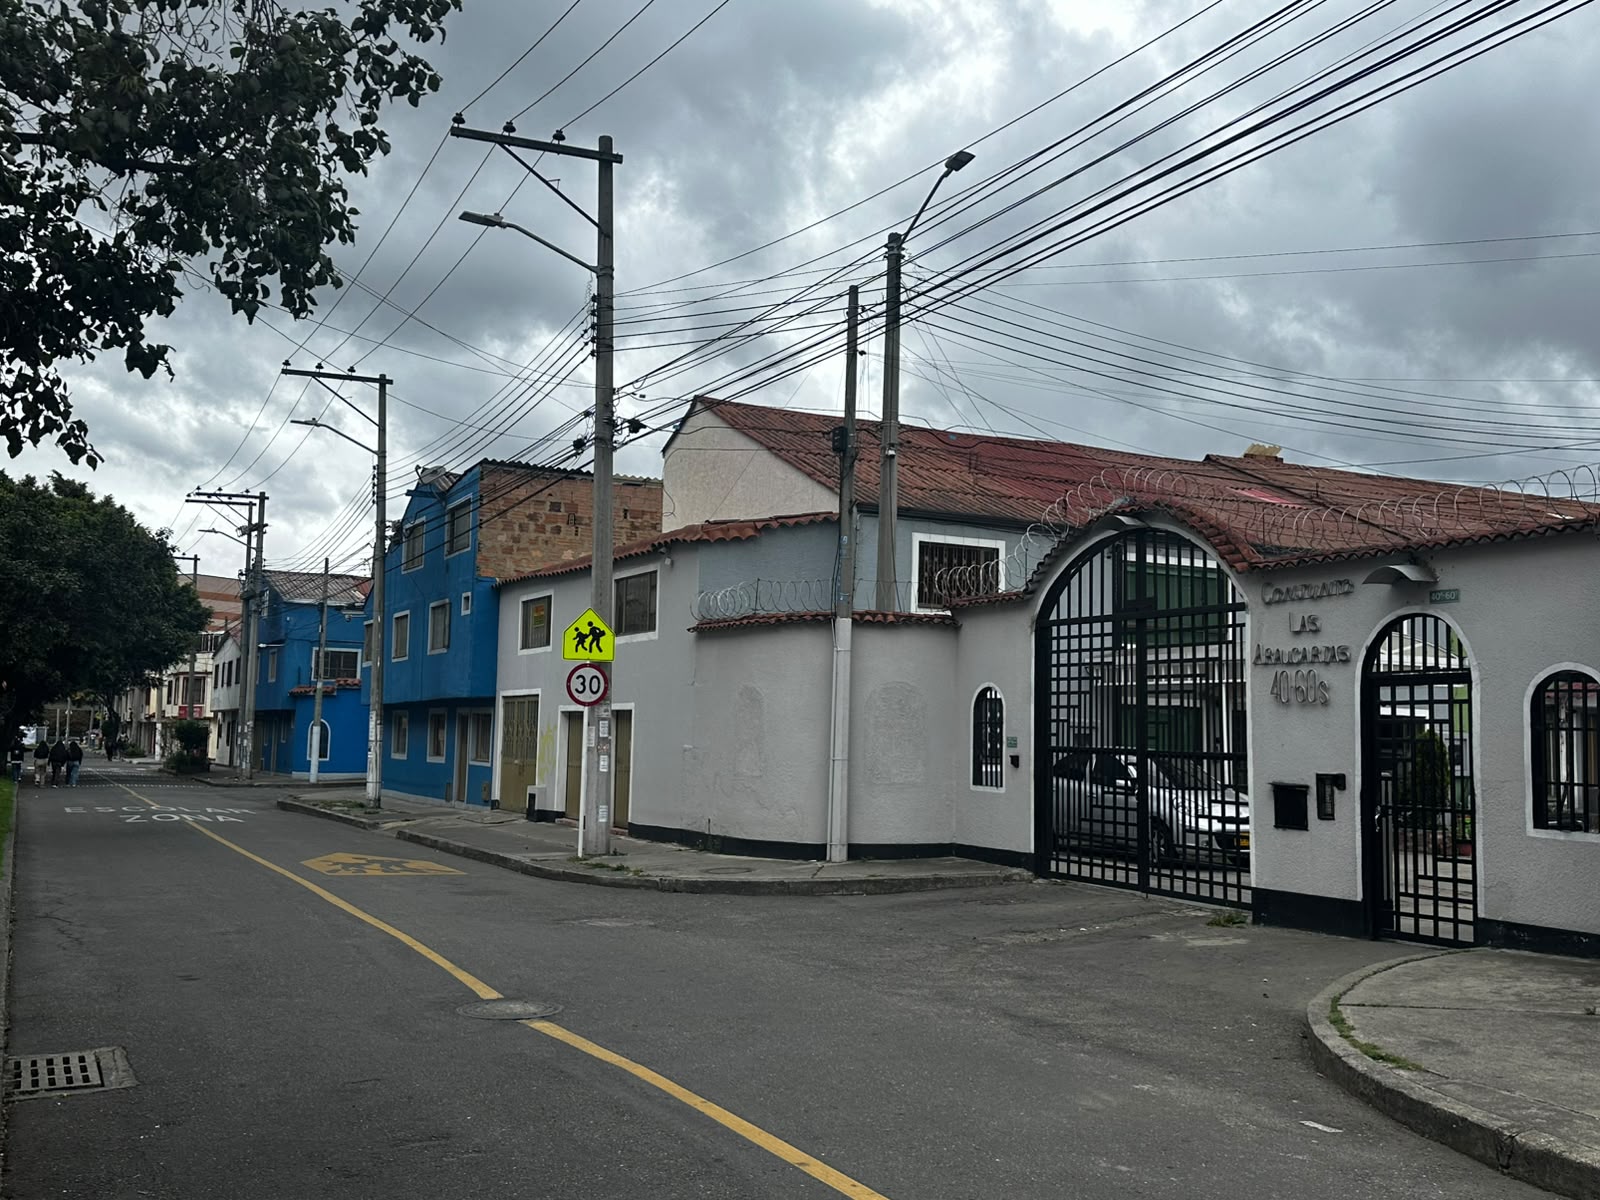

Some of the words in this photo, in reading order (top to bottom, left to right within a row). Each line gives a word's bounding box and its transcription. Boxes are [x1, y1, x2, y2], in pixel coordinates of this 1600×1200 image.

[1289, 612, 1322, 633] LAS
[574, 674, 601, 695] 30
[64, 806, 257, 814] ESCOLAR
[119, 813, 246, 823] ZONA
